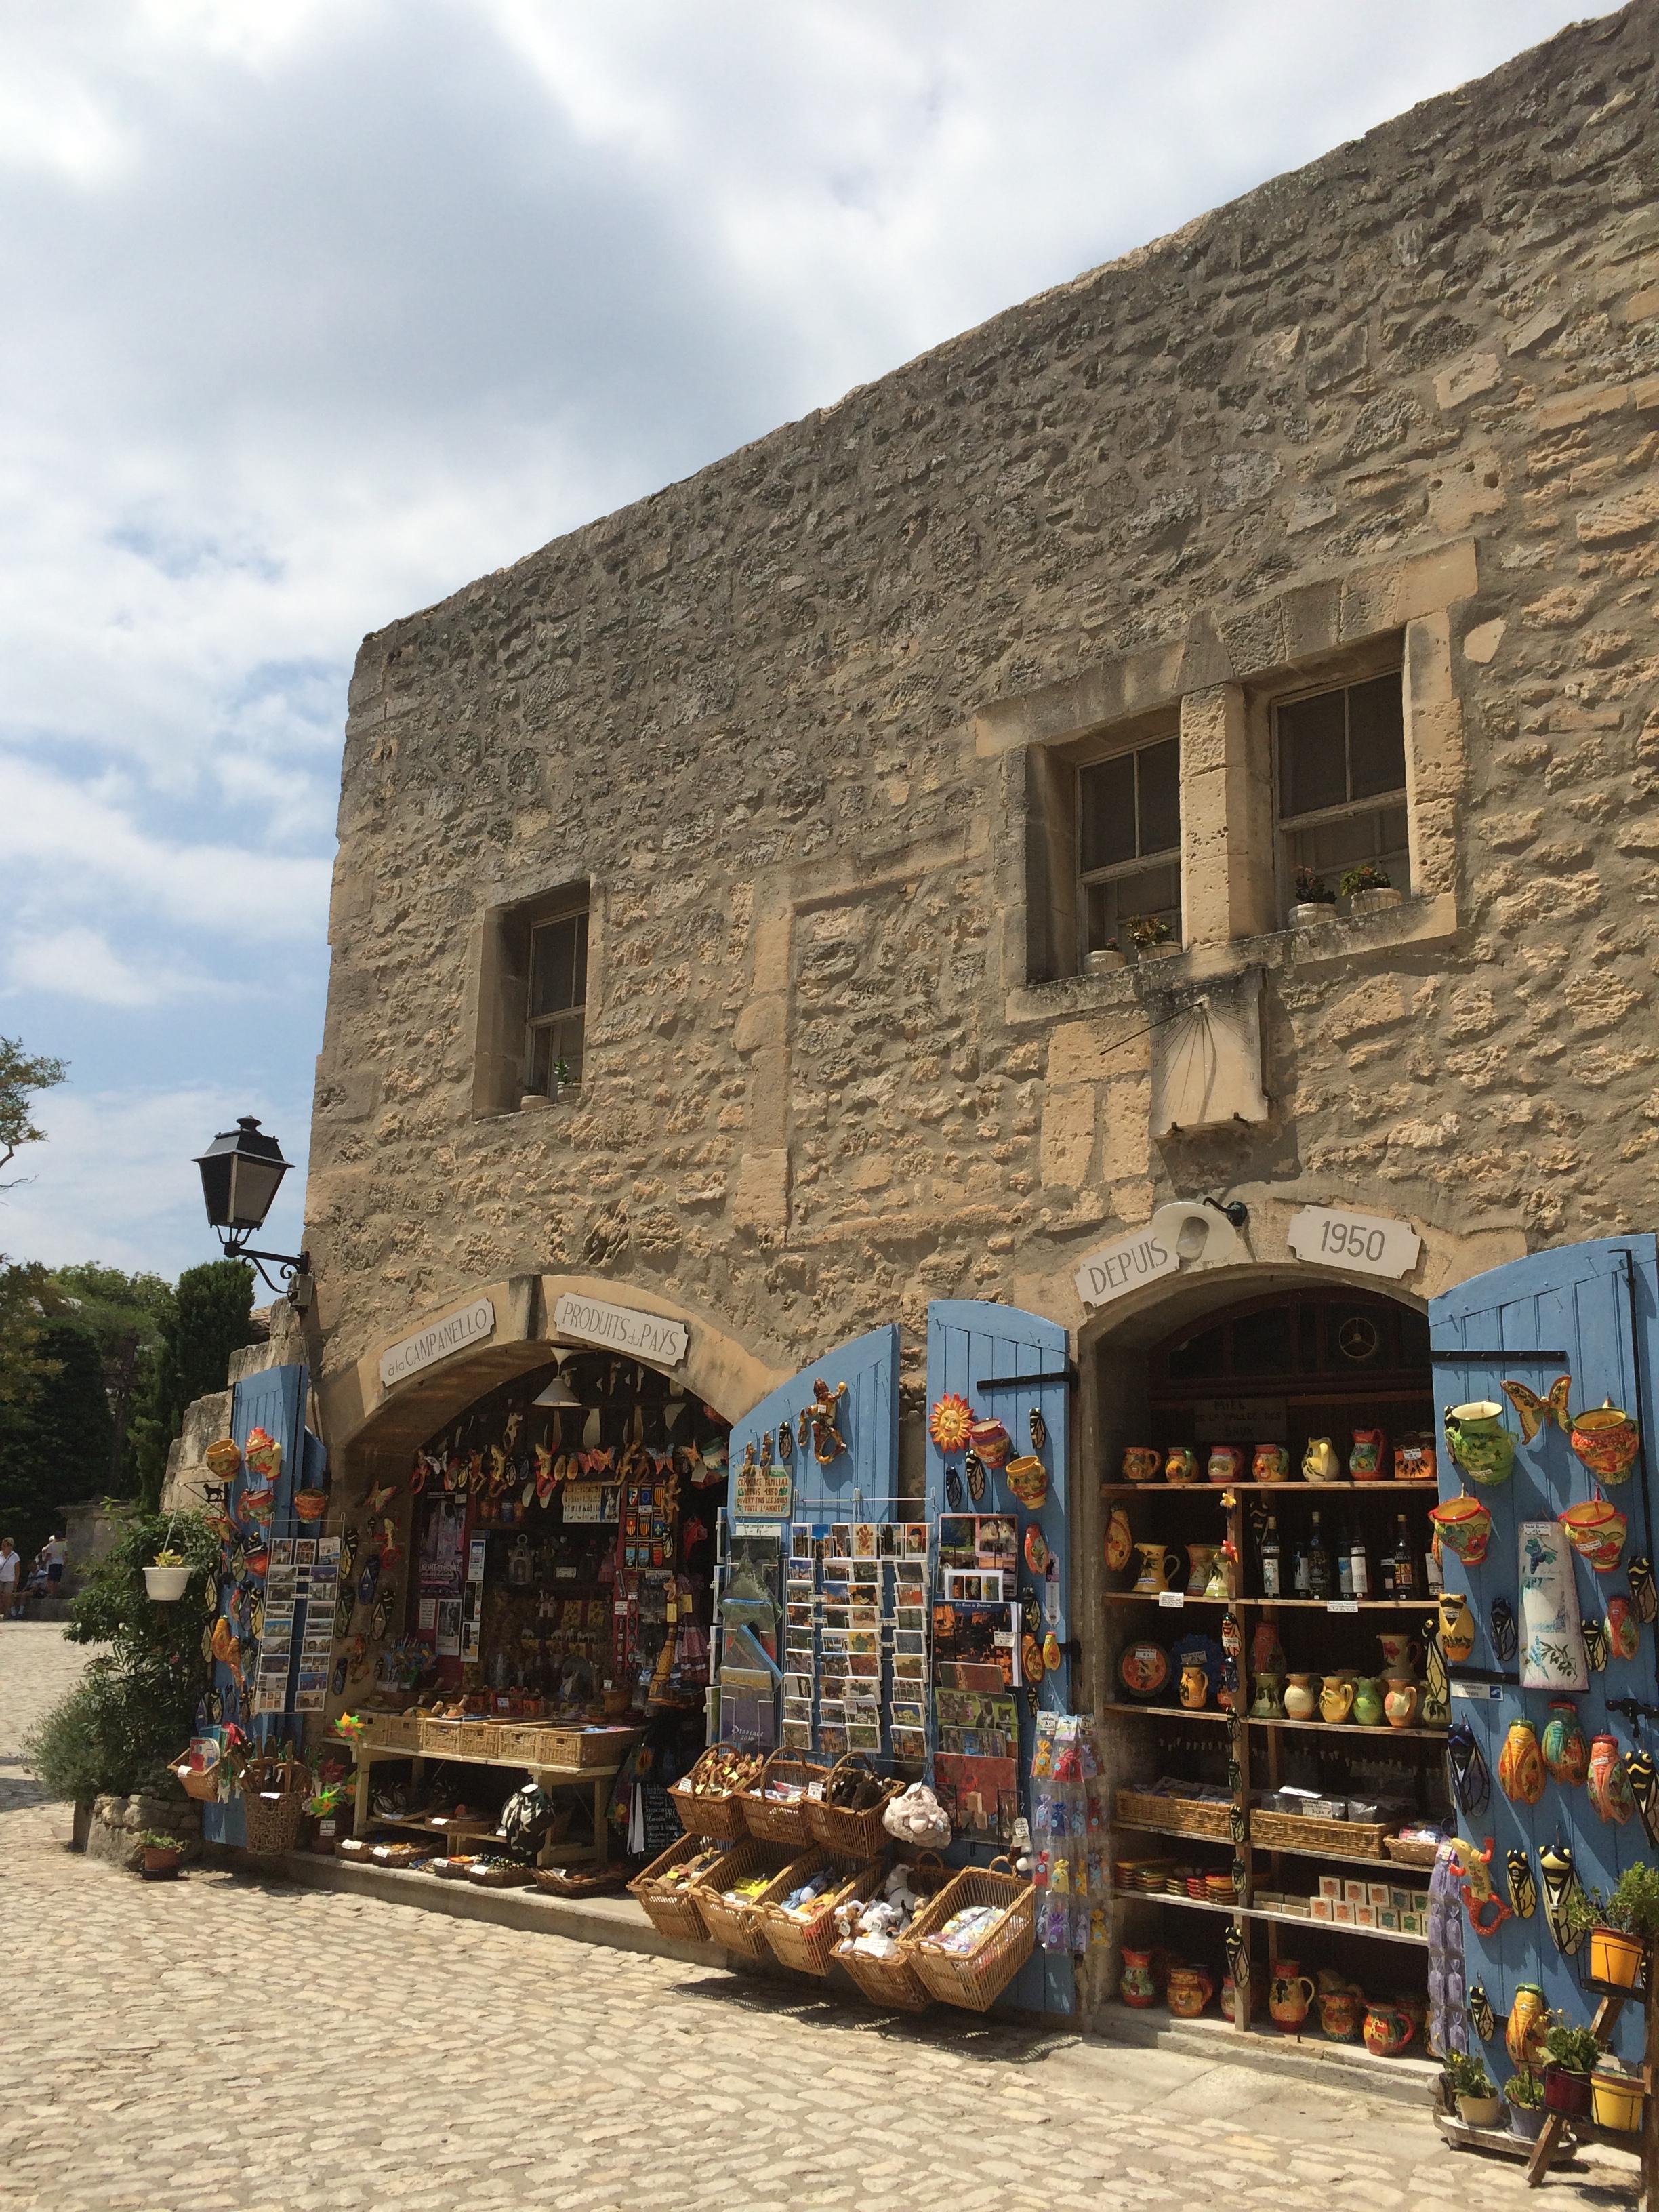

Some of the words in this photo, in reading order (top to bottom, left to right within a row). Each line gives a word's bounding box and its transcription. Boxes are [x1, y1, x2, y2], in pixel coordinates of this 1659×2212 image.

[1320, 1220, 1385, 1262] 1950
[1088, 1237, 1168, 1296] DEPUIS
[388, 1362, 395, 1376] à
[396, 1359, 405, 1373] la
[405, 1307, 487, 1366] CAMPANELLO
[562, 1301, 630, 1342] PRODUITS
[627, 1329, 640, 1346] du
[639, 1323, 679, 1356] PAYS
[765, 1477, 788, 1486] FAMILIAL
[731, 1724, 764, 1737] Provence
